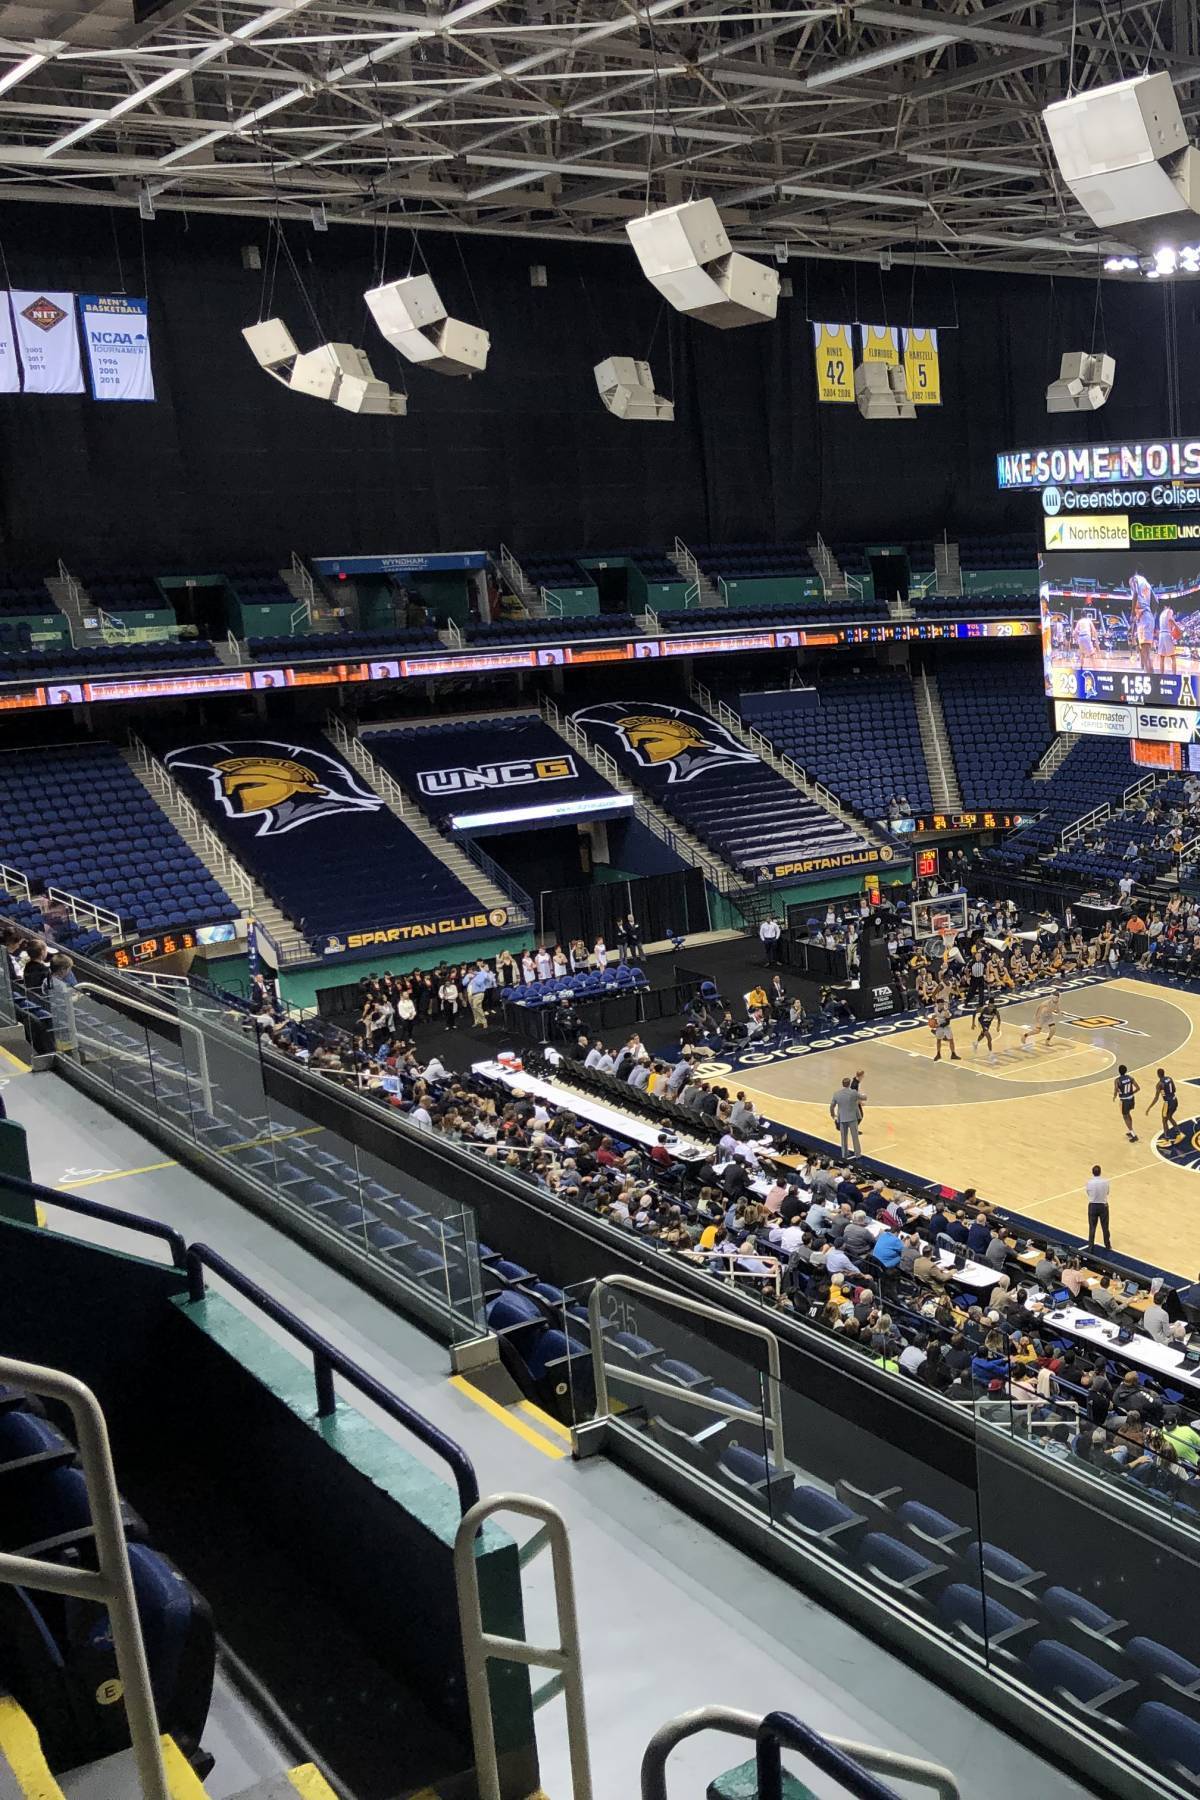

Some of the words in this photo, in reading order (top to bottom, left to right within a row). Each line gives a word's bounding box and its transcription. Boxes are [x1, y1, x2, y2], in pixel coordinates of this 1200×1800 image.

[99, 298, 128, 306] MEN'S
[86, 304, 142, 313] BASKETBALL
[32, 311, 57, 319] NIT
[91, 332, 133, 344] NCAA
[98, 358, 118, 366] 1996
[826, 361, 845, 385] 42
[918, 364, 927, 387] 5
[1036, 448, 1111, 482] SOME
[1064, 489, 1146, 509] Greensboro
[1069, 526, 1127, 540] NorthState
[1131, 523, 1177, 540] GREEN
[885, 629, 893, 637] 11
[909, 628, 919, 636] 14
[934, 627, 942, 635] 21
[997, 625, 1012, 637] 29
[1058, 674, 1078, 694] 29
[1121, 675, 1151, 695] 1:55
[1080, 709, 1126, 722] ticketmaster
[1140, 715, 1189, 729] SEGRA
[425, 760, 570, 791] UNCG
[935, 821, 946, 829] 29
[985, 819, 996, 827] 26
[775, 857, 840, 876] SPARTAN
[842, 850, 878, 865] CLUB
[920, 860, 934, 874] 30
[348, 923, 436, 948] SPARTAN
[439, 915, 487, 932] CLUB
[164, 941, 176, 952] 26
[185, 937, 193, 947] 3
[118, 956, 129, 967] 29
[872, 986, 893, 996] TFA
[1124, 1084, 1131, 1094] 11
[607, 1295, 638, 1335] 215
[105, 1685, 115, 1698] E
